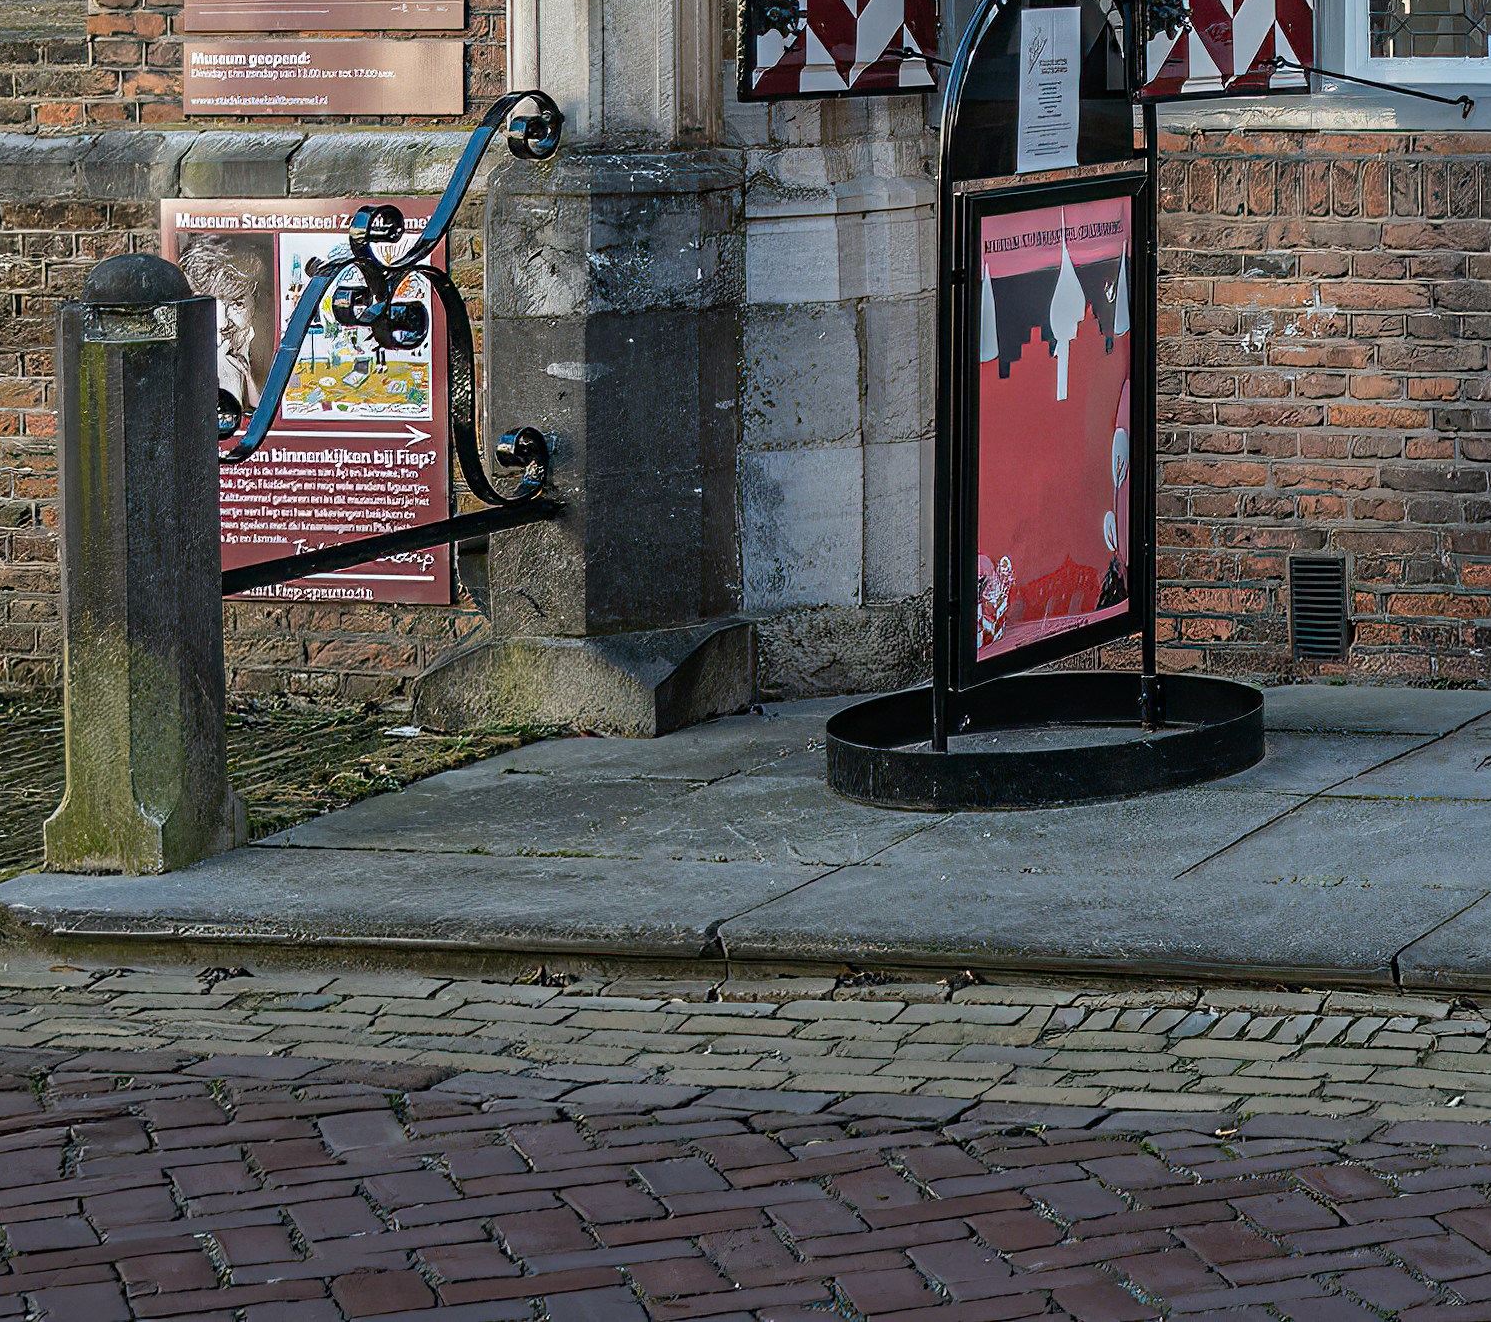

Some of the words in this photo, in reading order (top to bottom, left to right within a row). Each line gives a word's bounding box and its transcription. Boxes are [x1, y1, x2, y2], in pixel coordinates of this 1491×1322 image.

[191, 51, 246, 65] Museum
[249, 51, 311, 68] geopend:
[175, 213, 240, 228] Museum
[241, 213, 337, 229] Stadskasteel
[271, 447, 371, 468] binnenkijken
[373, 449, 394, 468] bij
[396, 449, 437, 469] Fiep?
